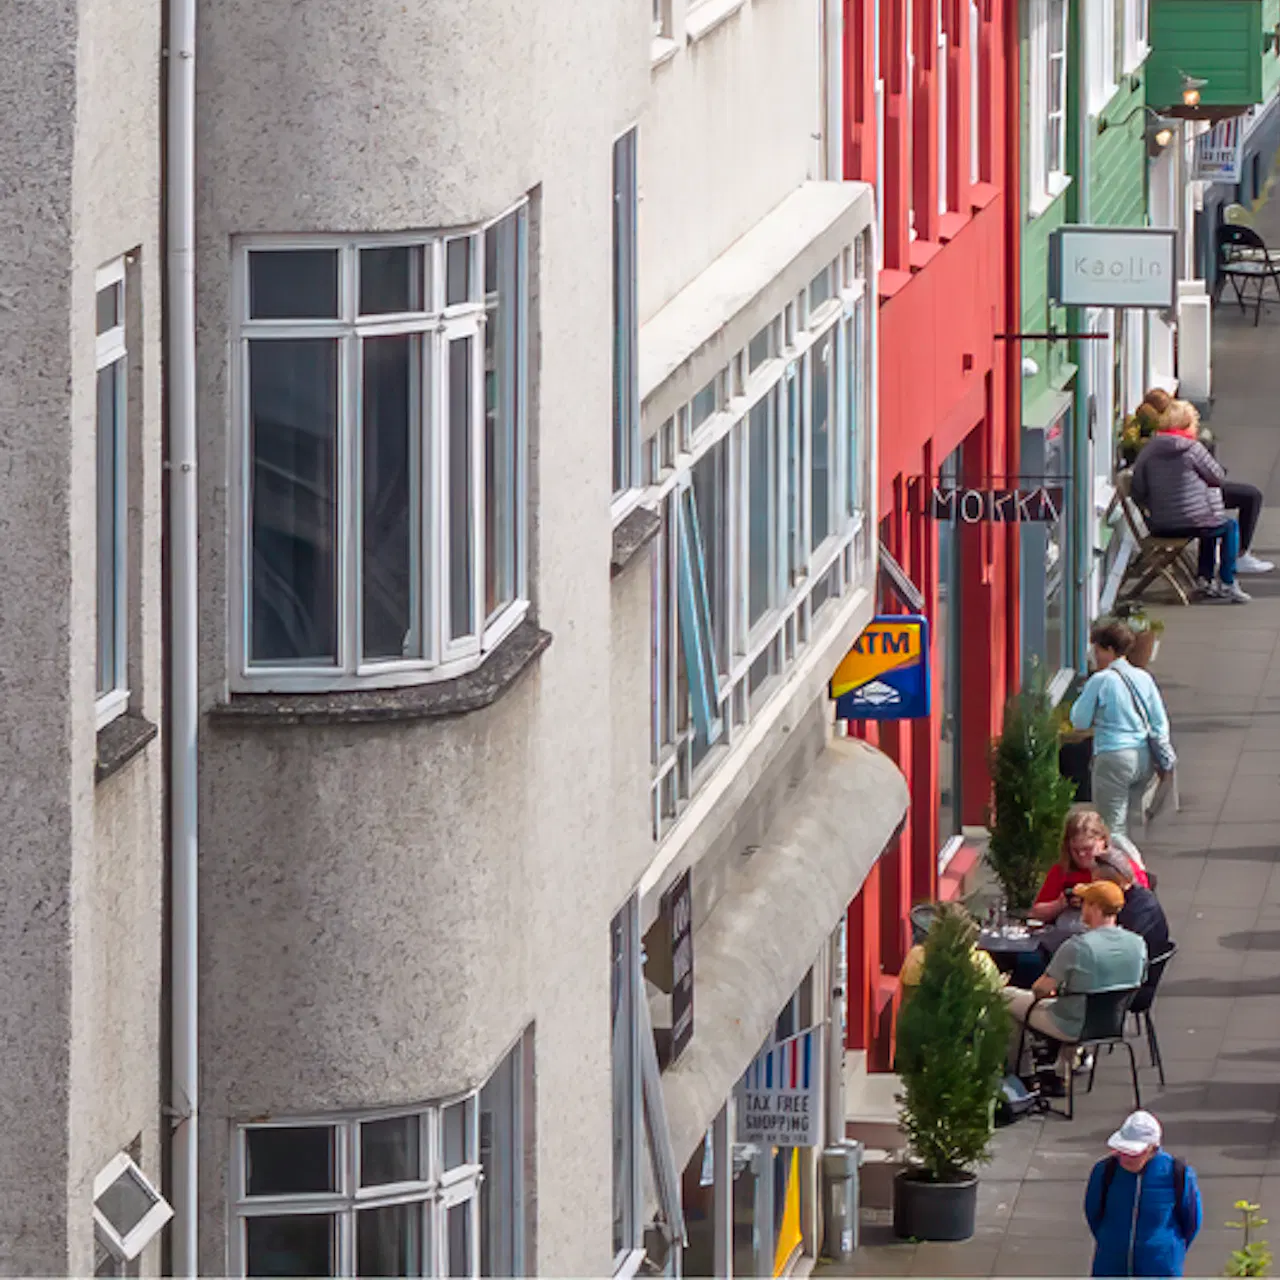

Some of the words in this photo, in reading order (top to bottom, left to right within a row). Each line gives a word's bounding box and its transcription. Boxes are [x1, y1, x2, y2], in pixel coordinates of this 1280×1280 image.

[1074, 256, 1162, 277] Kaolin
[932, 485, 1060, 524] MOKKA
[746, 1093, 771, 1111] TAX
[777, 1095, 809, 1112] FREE
[745, 1114, 809, 1132] SHOPPING
